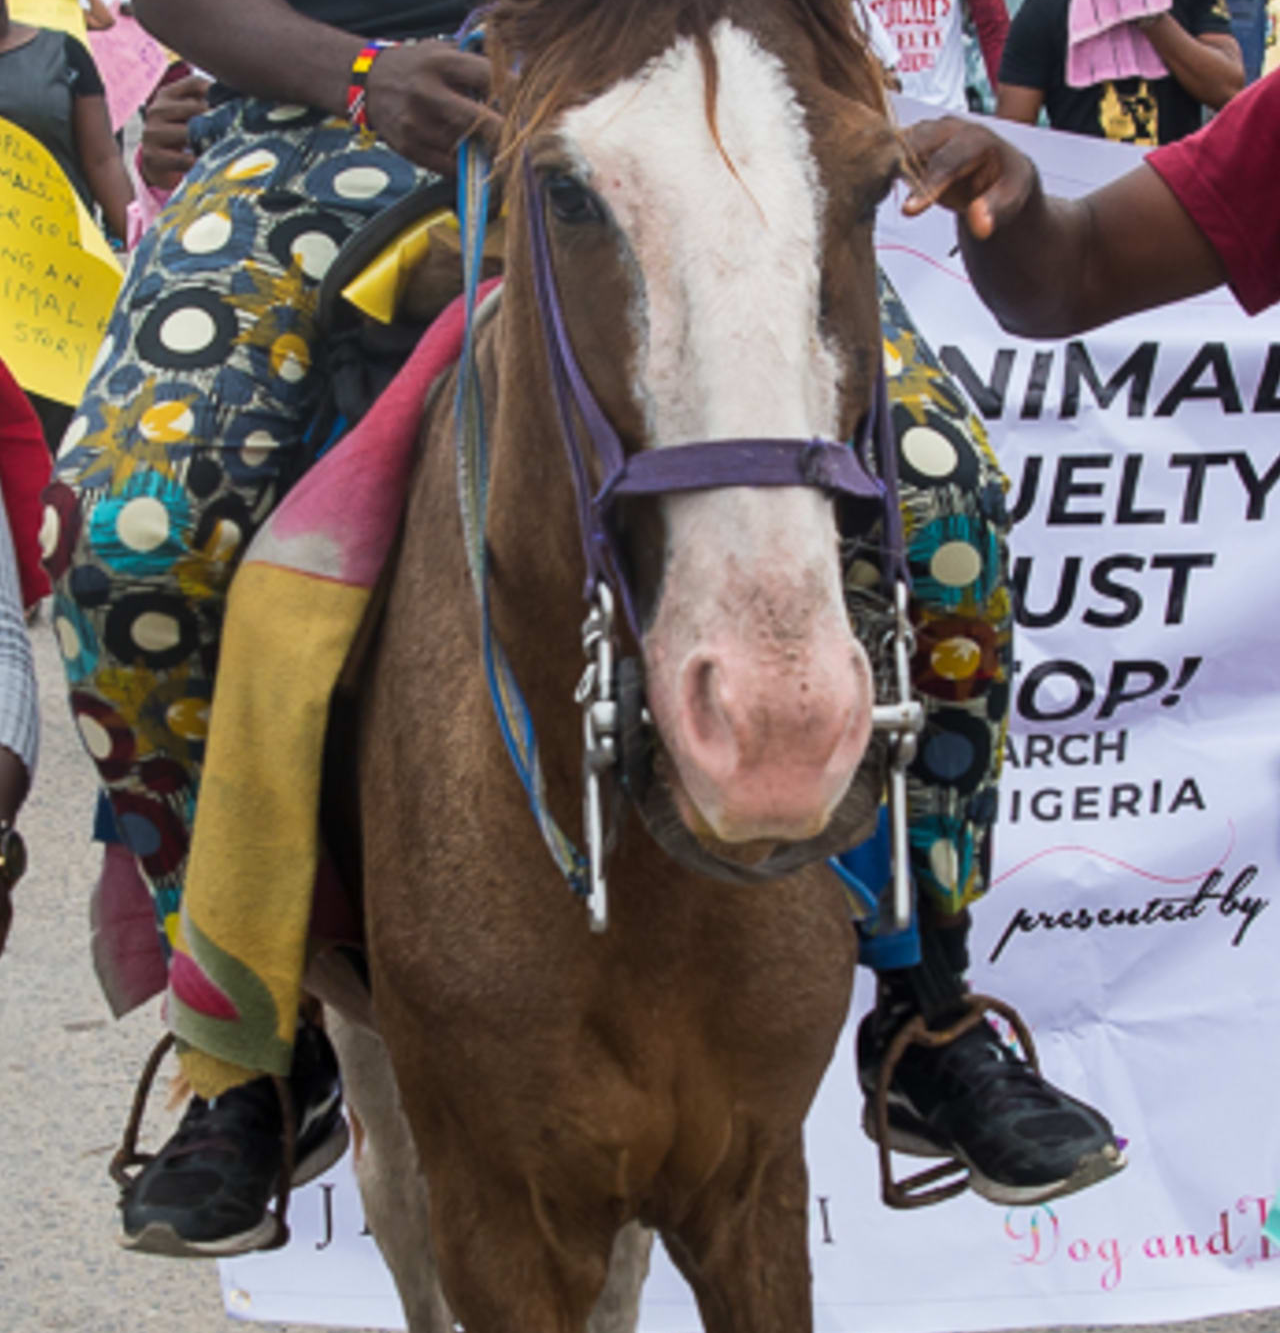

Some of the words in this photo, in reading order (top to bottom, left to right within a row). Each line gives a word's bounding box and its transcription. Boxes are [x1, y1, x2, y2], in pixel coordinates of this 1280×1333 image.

[45, 262, 84, 291] AN
[14, 321, 90, 376] STORY
[1008, 551, 1216, 629] UST
[1002, 729, 1128, 770] ARCH
[998, 776, 1207, 825] IGERIA
[989, 870, 1221, 965] presented
[1219, 864, 1270, 946] by
[1140, 1210, 1248, 1261] and
